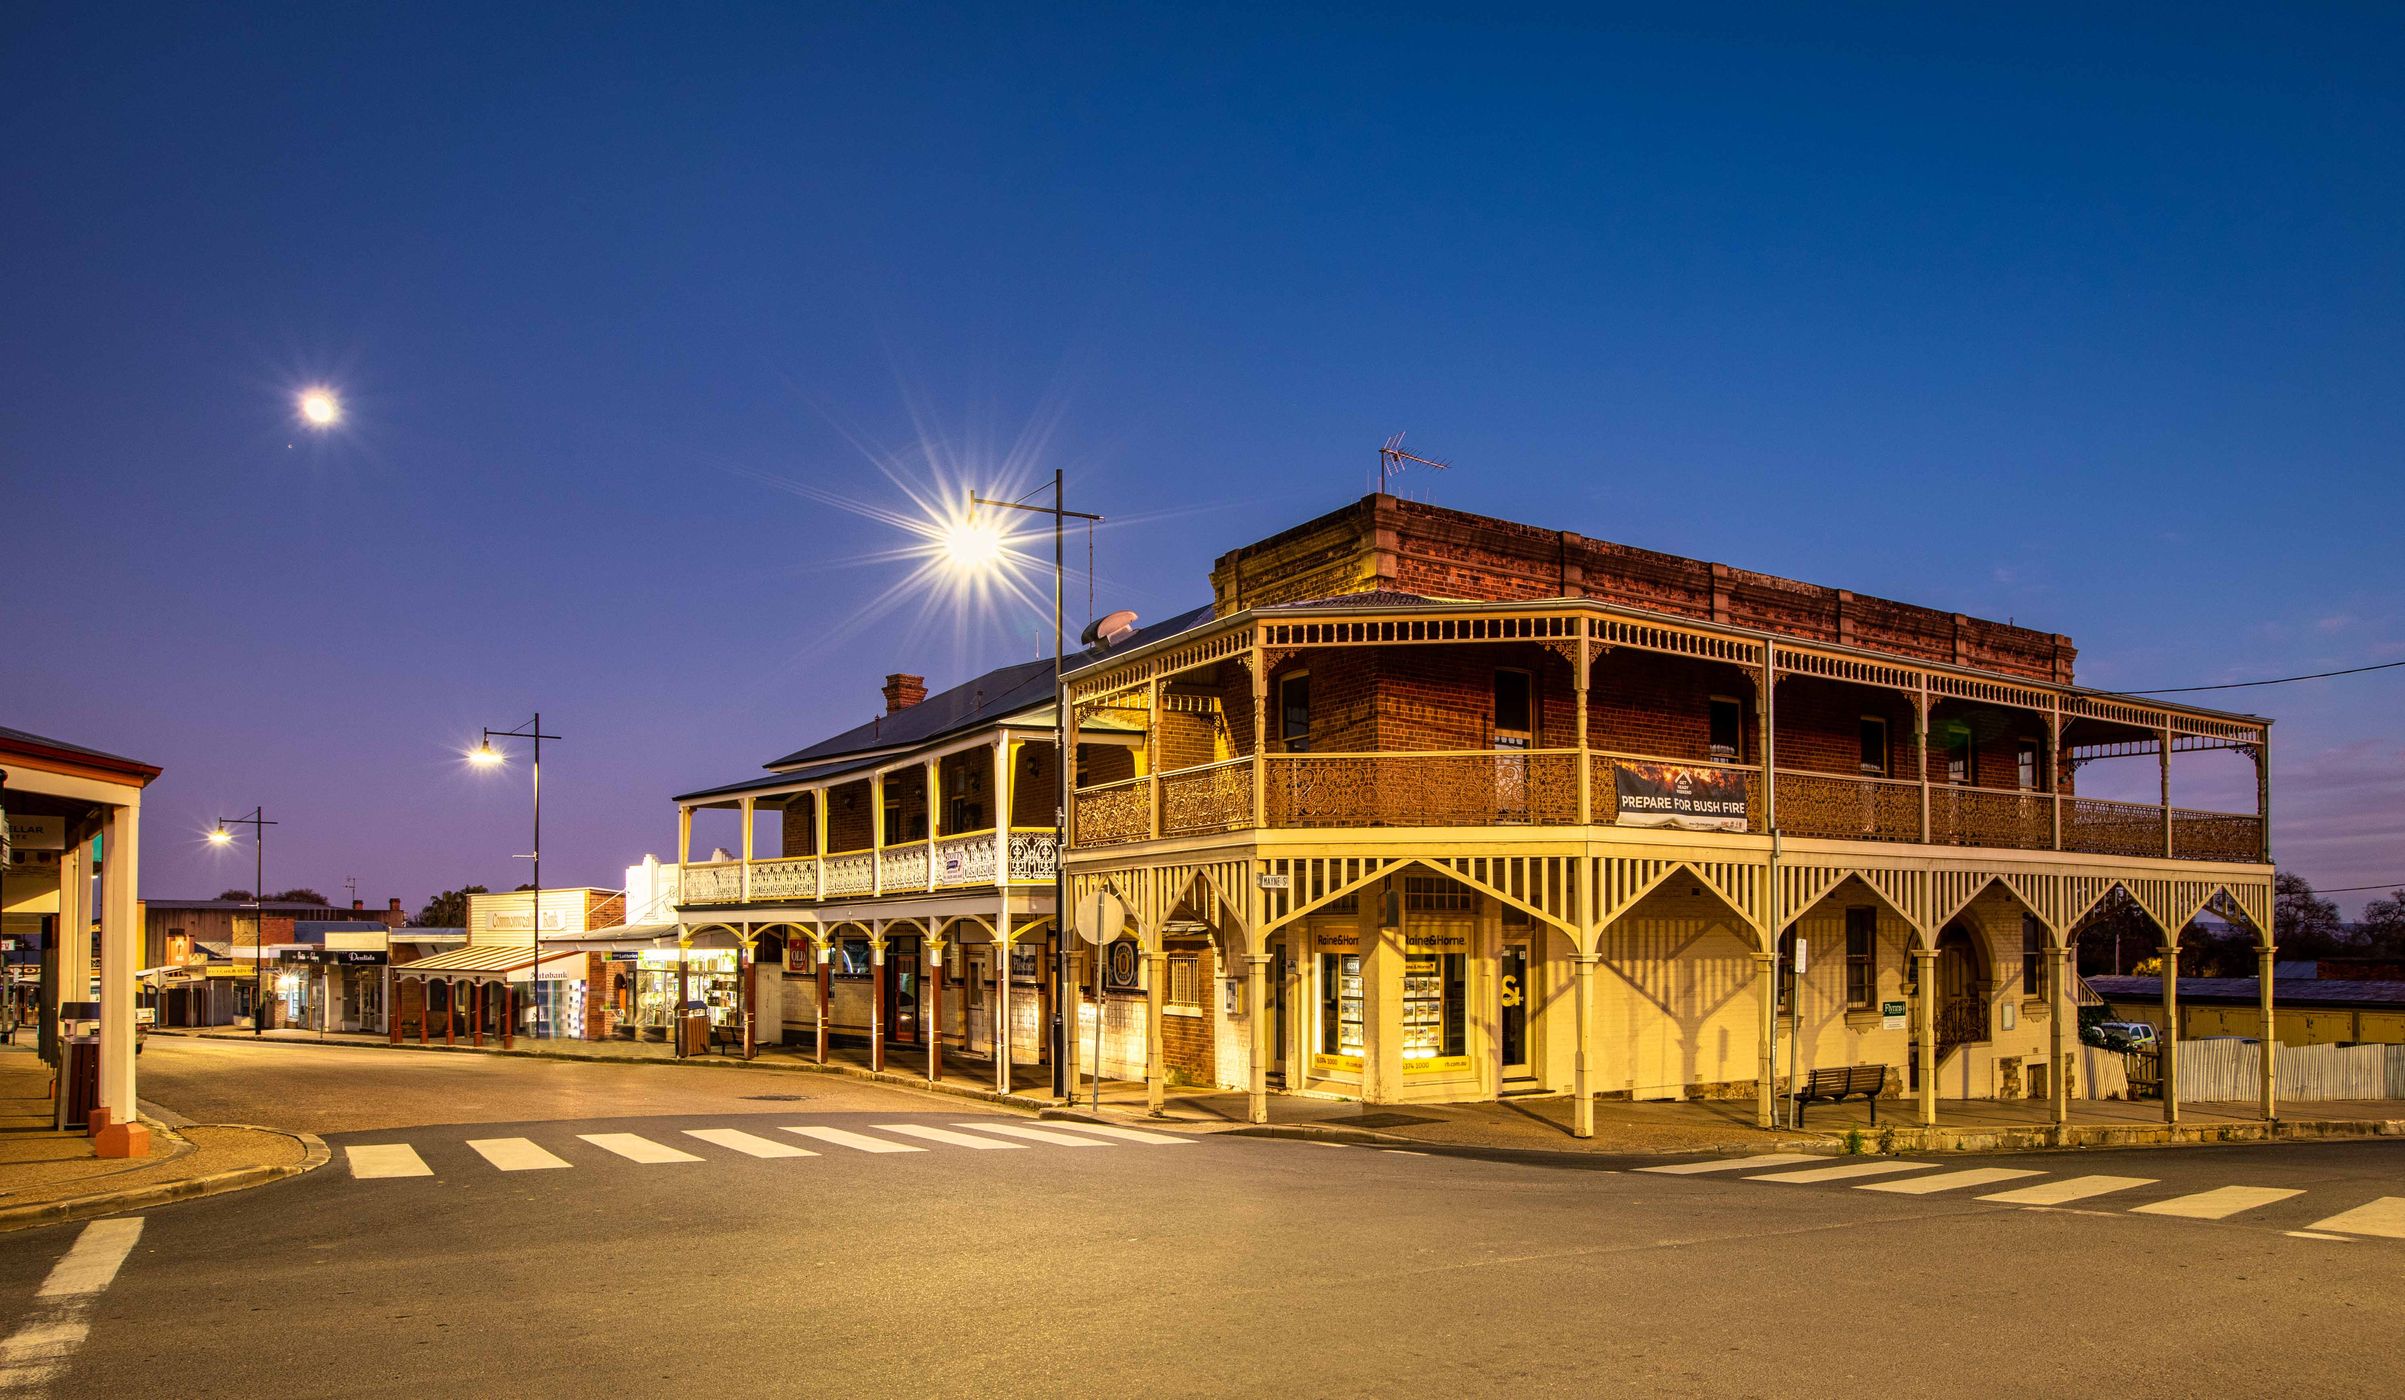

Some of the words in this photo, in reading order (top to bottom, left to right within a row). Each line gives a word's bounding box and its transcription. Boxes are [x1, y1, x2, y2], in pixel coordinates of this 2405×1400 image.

[1621, 795, 1673, 809] PREPARE
[1674, 798, 1692, 811] FOR
[1693, 800, 1720, 813] BUSH
[1722, 802, 1745, 814] FIRE
[1263, 876, 1280, 887] MAYNE
